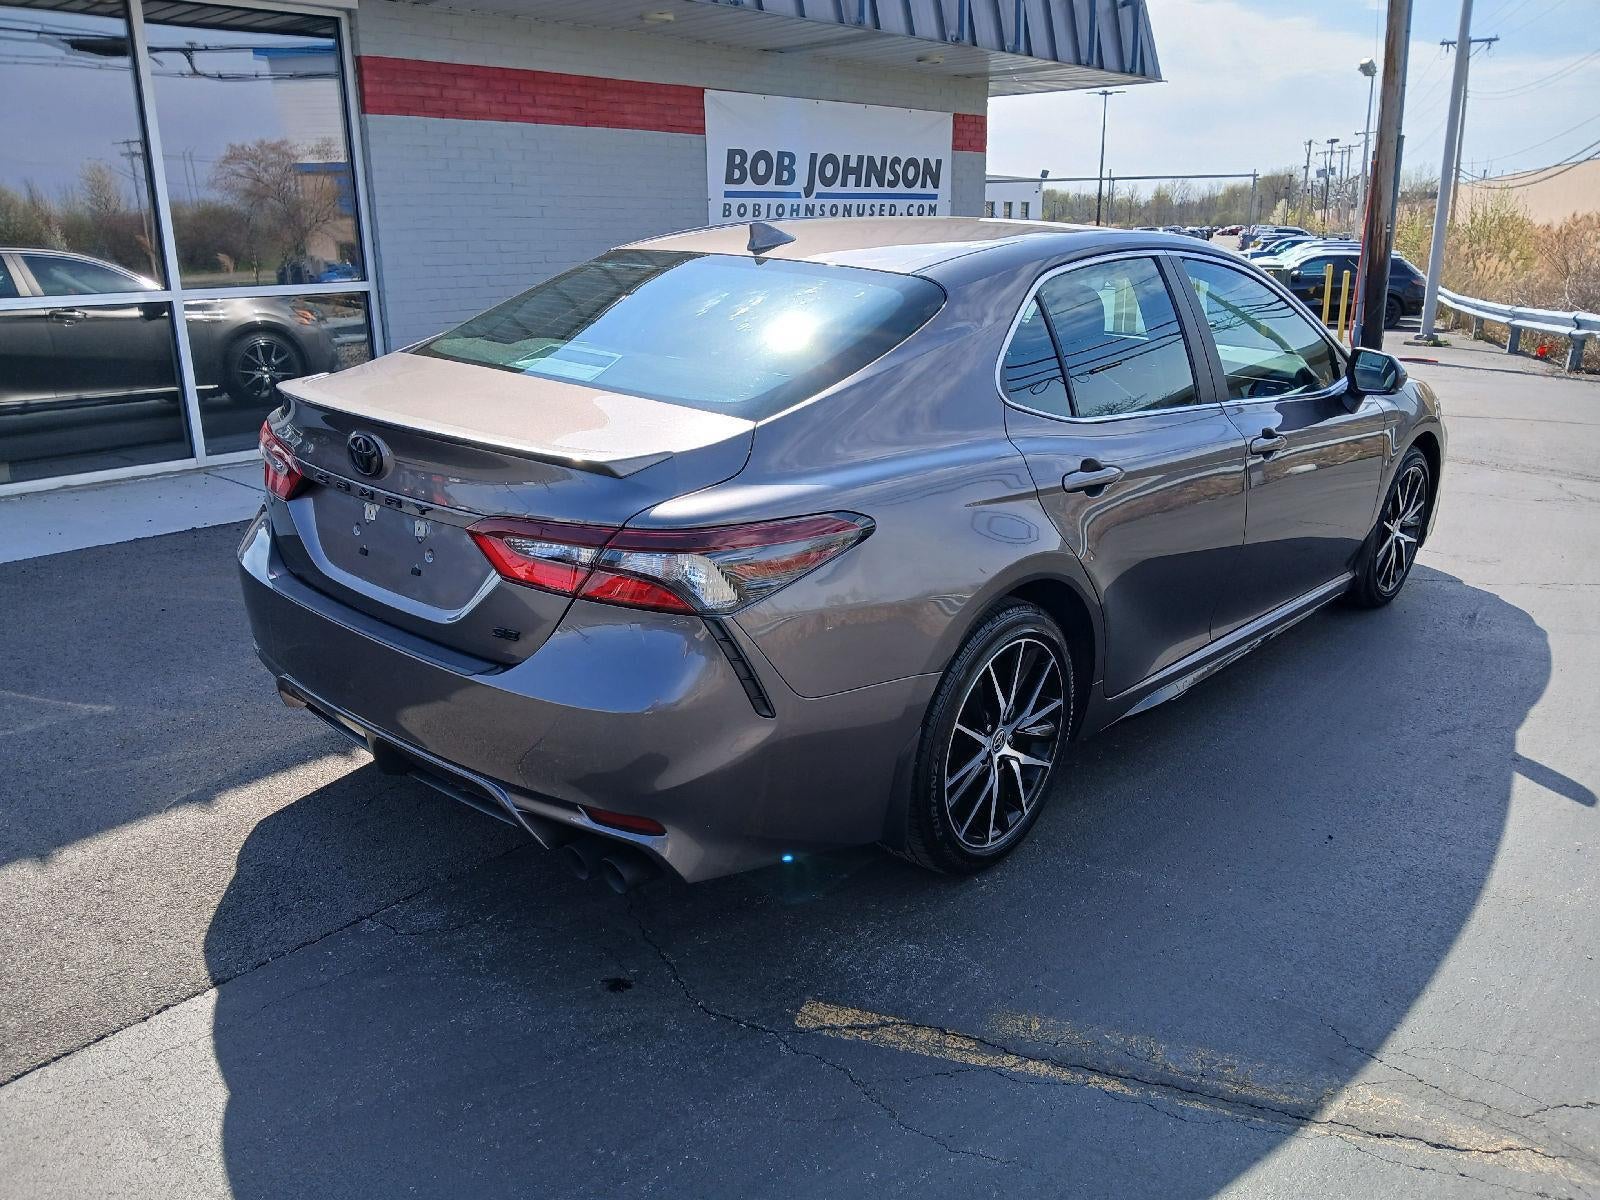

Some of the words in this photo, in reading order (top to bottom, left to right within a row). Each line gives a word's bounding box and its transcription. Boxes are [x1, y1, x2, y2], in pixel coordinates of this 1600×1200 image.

[724, 148, 797, 186] BOB
[803, 152, 943, 199] JOHNSON
[721, 202, 938, 219] BOBJOHNSONUSED.COM
